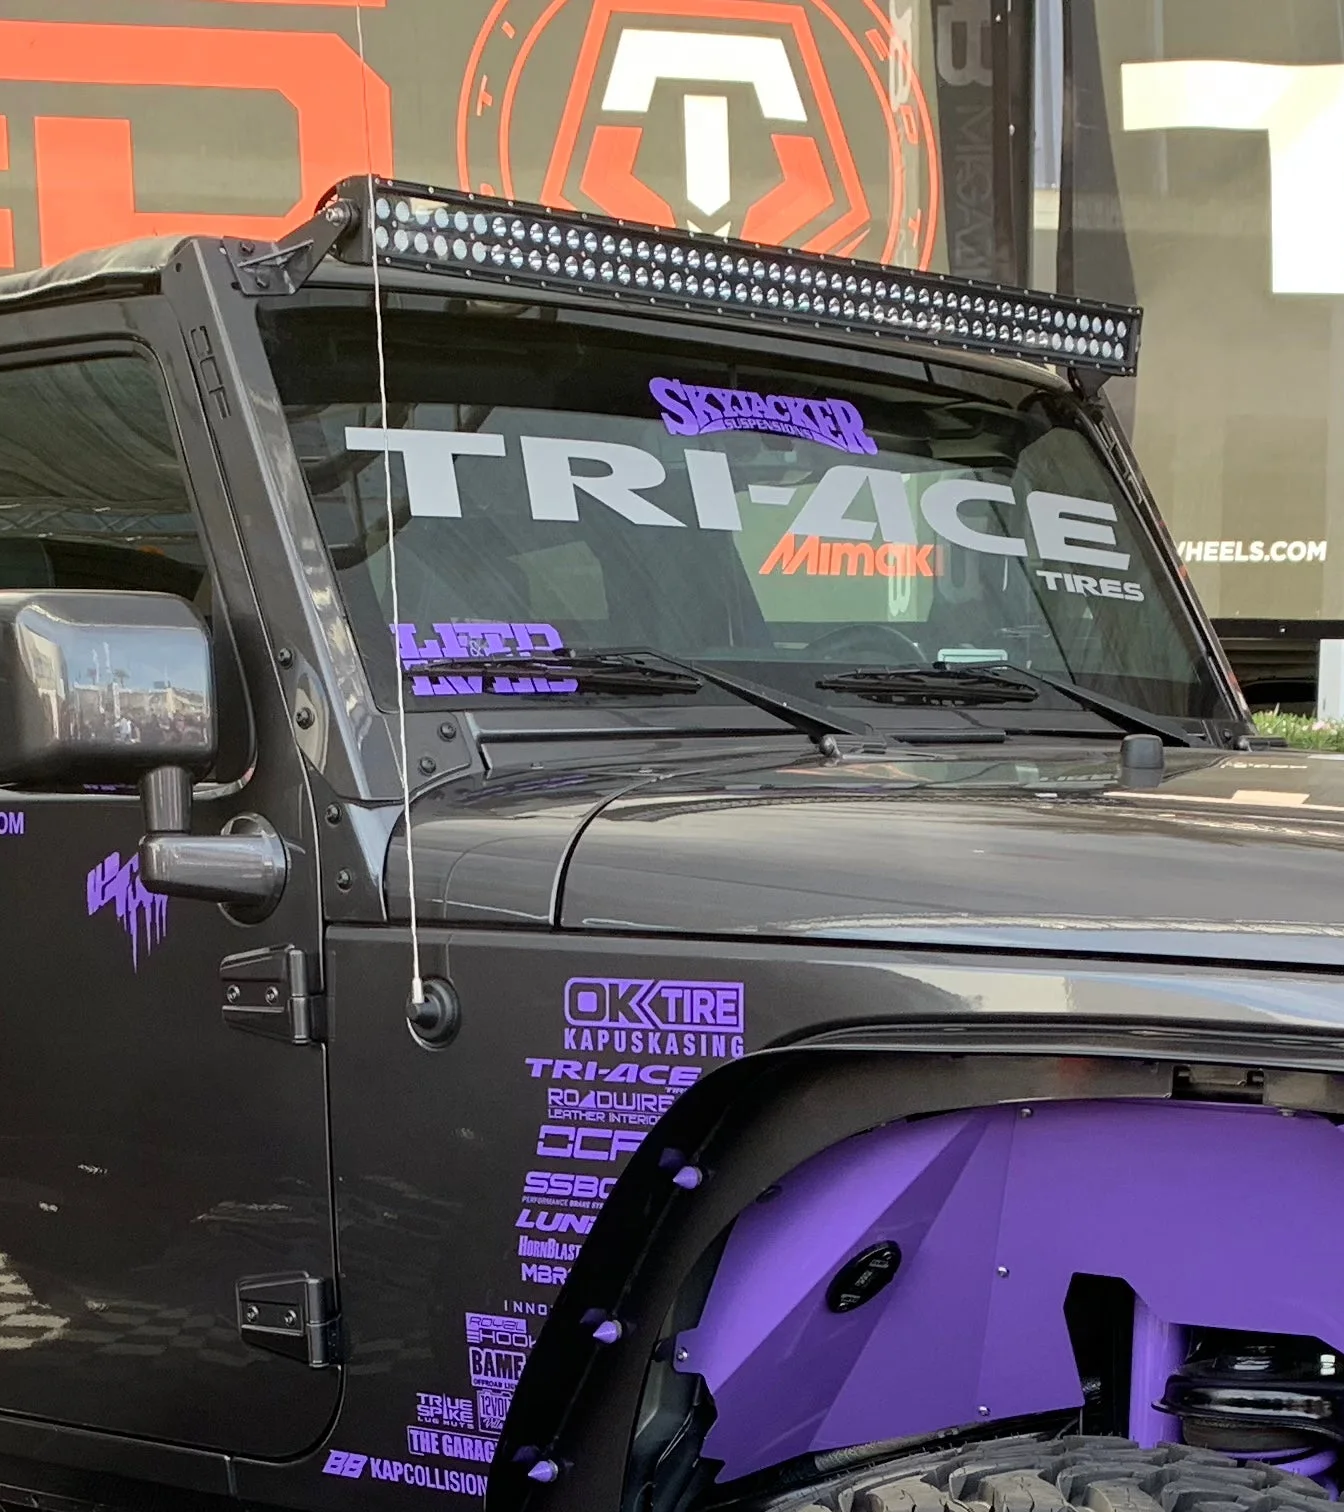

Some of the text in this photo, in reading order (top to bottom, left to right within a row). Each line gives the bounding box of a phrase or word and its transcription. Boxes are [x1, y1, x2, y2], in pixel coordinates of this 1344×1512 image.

[648, 376, 879, 456] SKYJACKER
[345, 426, 1130, 571] TRI-ACE
[1177, 540, 1328, 563] HEELS.COM
[1036, 570, 1145, 603] TIRES
[660, 987, 741, 1026] TIRE
[563, 1027, 745, 1059] KAPUSKASING
[524, 1056, 703, 1087] TRI-ACE
[547, 1108, 661, 1126] LEATHER INTERIO
[417, 1415, 440, 1425] LUG
[409, 1429, 498, 1464] THE GARAG
